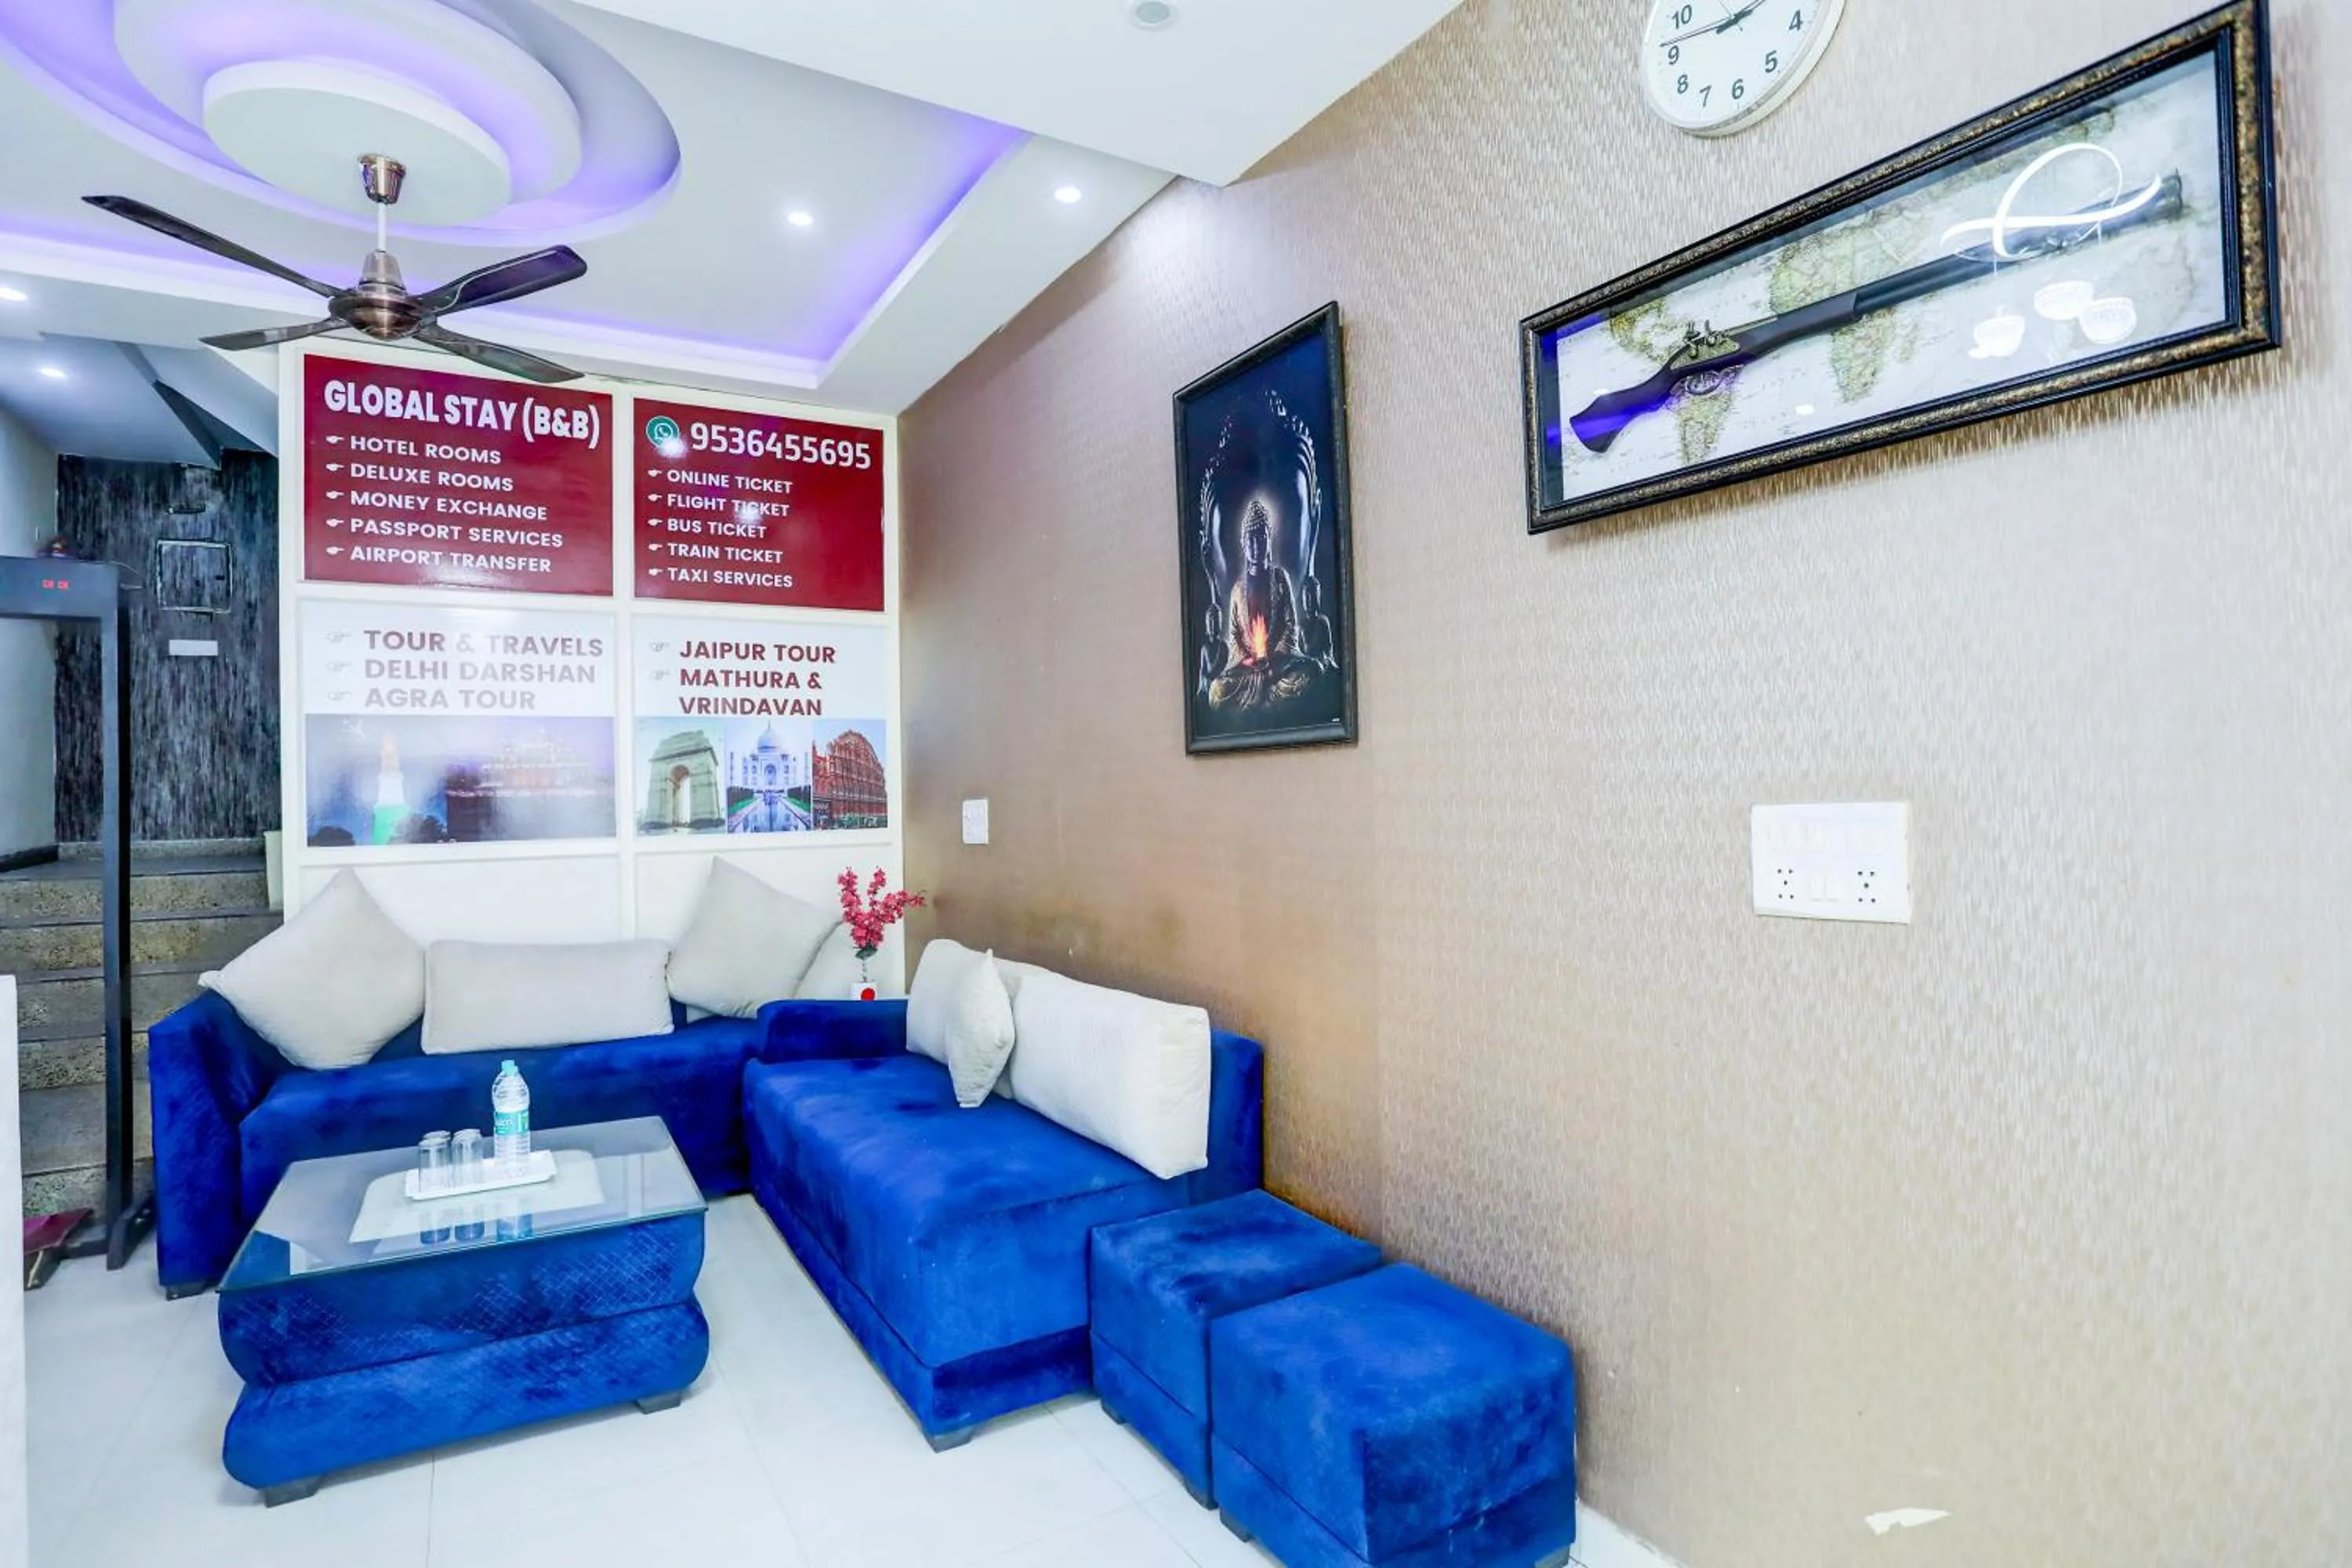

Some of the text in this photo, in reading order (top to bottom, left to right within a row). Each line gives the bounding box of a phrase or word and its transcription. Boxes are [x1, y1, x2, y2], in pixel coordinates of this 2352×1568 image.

[1671, 5, 1693, 29] 10
[1789, 10, 1803, 31] 4
[1668, 45, 1679, 65] 9
[1765, 50, 1777, 73] 5
[1677, 74, 1688, 94] 8
[1732, 78, 1744, 100] 6
[1699, 85, 1711, 107] 7
[325, 380, 599, 448] GLOBAL STAY (B&B)
[350, 435, 501, 464] HOTEL ROOMS
[691, 423, 871, 469] 9536455695
[350, 463, 513, 492] DELUXE ROOMS
[667, 470, 793, 493] ONLINE TICKET
[350, 491, 547, 521] MONEY EXCHANGE
[667, 493, 789, 517] FLIGHT TICKET
[350, 518, 563, 548] PASSPORT SERVICES
[668, 518, 767, 539] BUS TICKET
[350, 546, 552, 572] AIRPORT TRANSFER
[667, 543, 782, 564] TRAIN TICKET
[667, 568, 793, 587] TAXI SERVICES
[364, 630, 603, 657] TOUR & TRAVELS
[680, 641, 836, 663] JAIPUR TOUR
[365, 659, 595, 683] DELHI DARSHAN
[680, 669, 822, 689] MATHURA &
[365, 688, 535, 710] AGRA TOUR
[679, 697, 822, 716] VRINDAVAN
